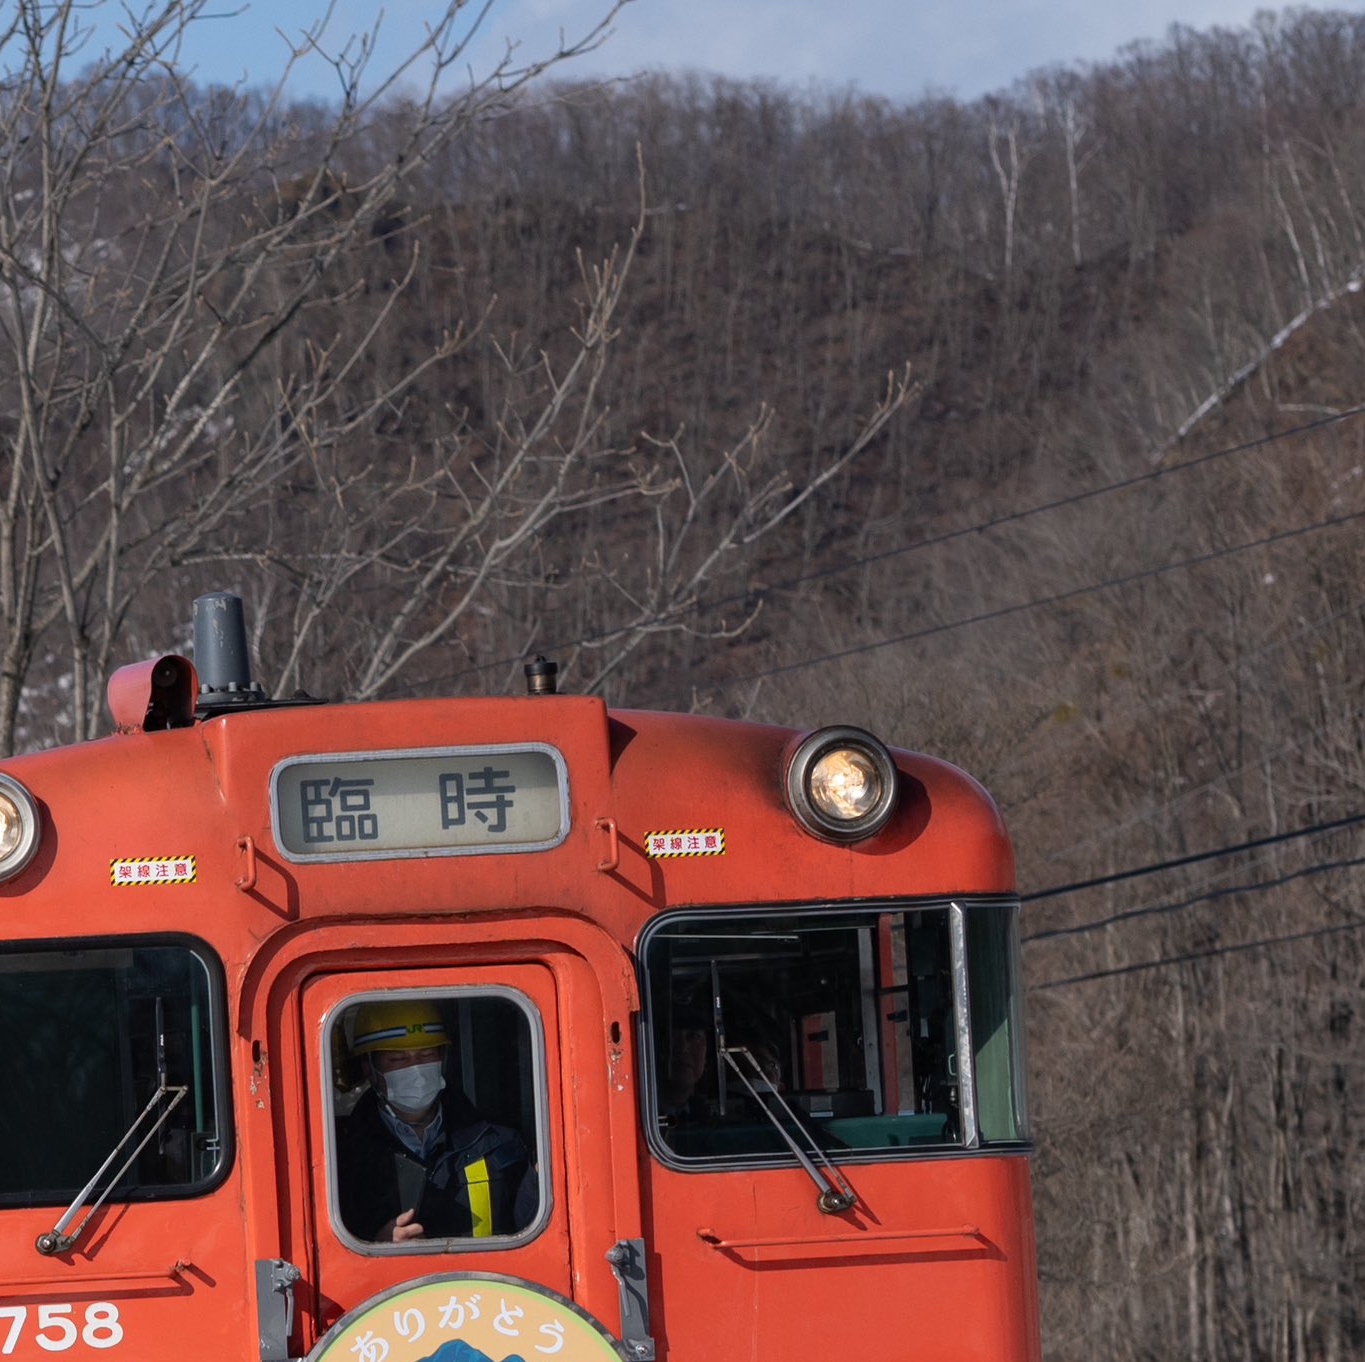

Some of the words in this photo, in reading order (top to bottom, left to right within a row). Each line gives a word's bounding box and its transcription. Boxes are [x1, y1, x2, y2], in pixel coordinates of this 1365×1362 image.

[299, 766, 517, 843] 臨時
[652, 834, 719, 851] 架線注意
[118, 863, 188, 879] 架線注意
